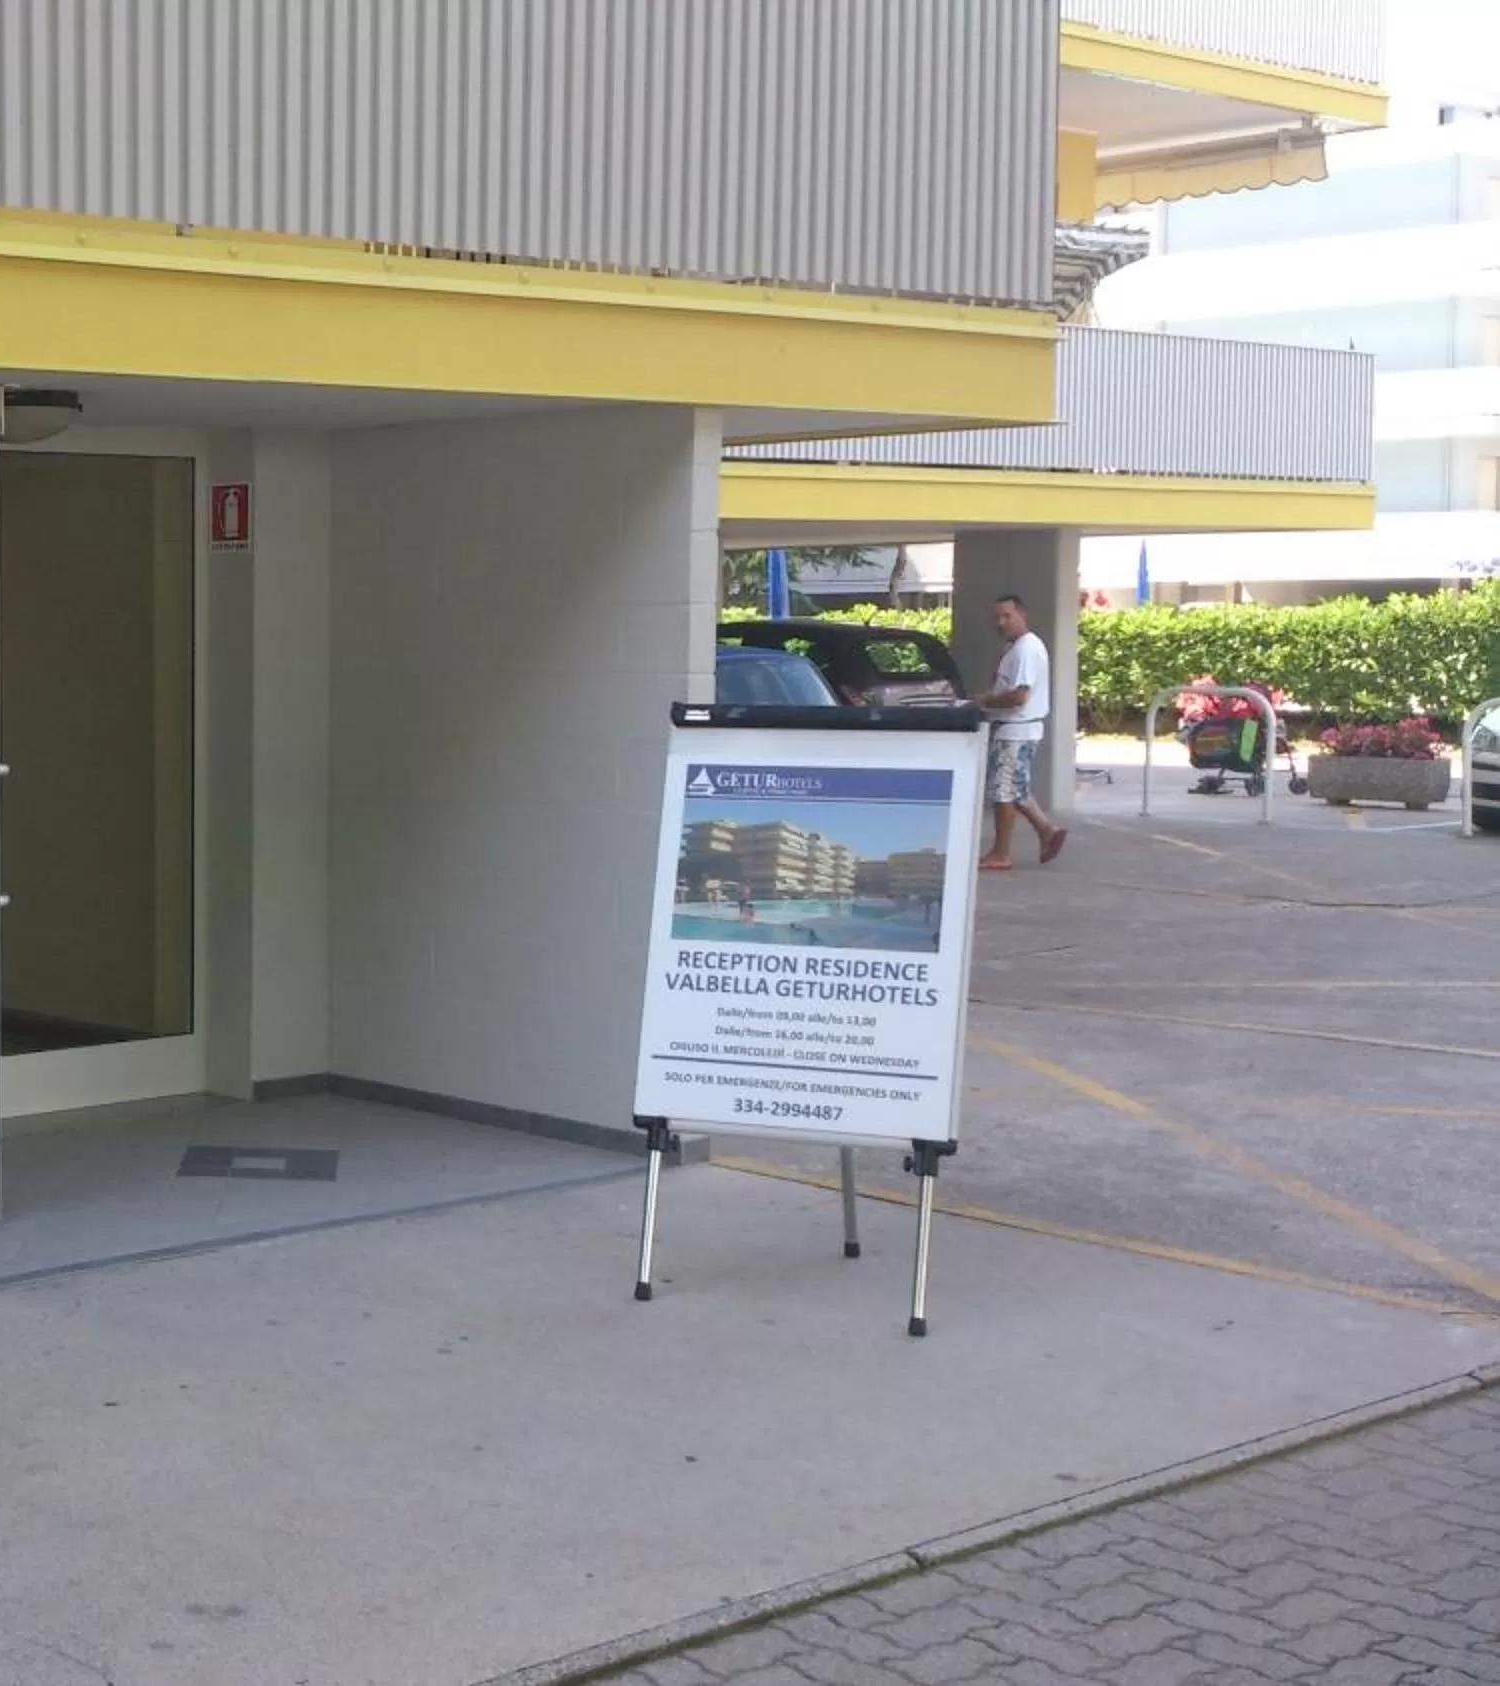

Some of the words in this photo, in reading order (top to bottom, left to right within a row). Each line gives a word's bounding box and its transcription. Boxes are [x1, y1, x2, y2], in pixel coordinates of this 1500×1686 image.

[676, 950, 798, 975] RECEPTION
[805, 958, 929, 983] RESIDENCE
[665, 973, 770, 996] VALBELLA
[775, 979, 938, 1007] GETURHOTELS
[793, 1049, 828, 1061] CLOSE
[829, 1052, 847, 1063] ON
[849, 1054, 921, 1068] WEDNESDAY
[665, 1072, 693, 1083] SOLO
[695, 1074, 714, 1085] PER
[810, 1083, 888, 1099] EMERGENCIES
[890, 1089, 921, 1101] ONLY
[733, 1097, 844, 1121] 334-2994487
